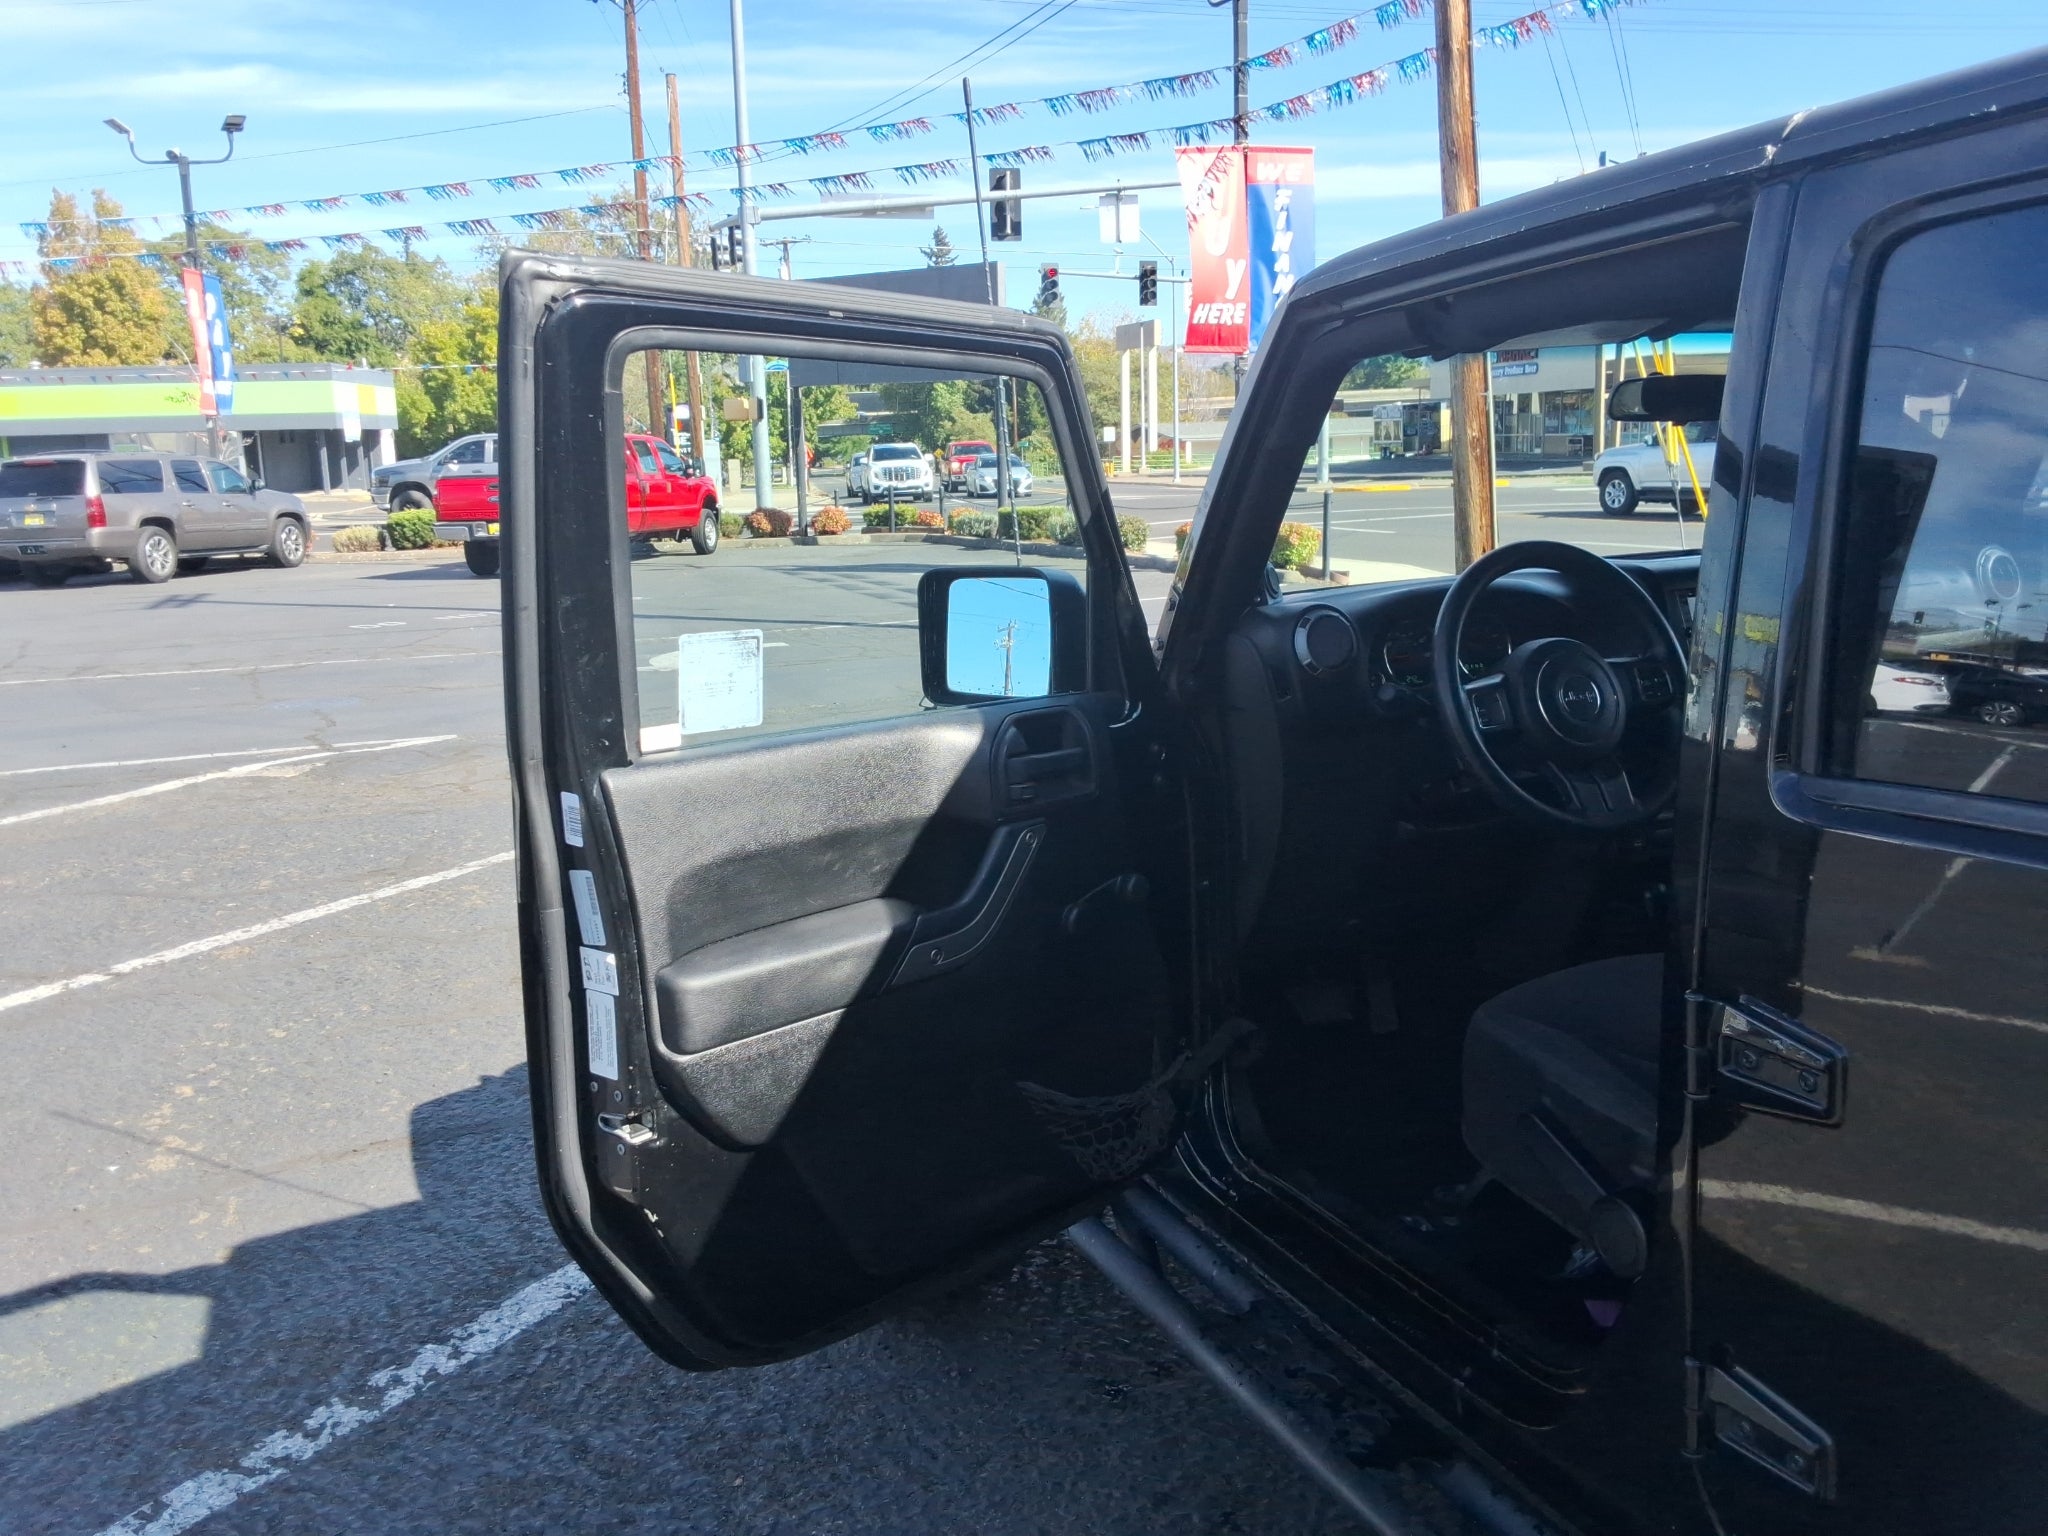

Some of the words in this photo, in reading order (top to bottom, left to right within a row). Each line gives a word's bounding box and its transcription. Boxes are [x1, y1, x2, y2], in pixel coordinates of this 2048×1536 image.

[1256, 162, 1305, 182] WE
[1272, 188, 1295, 309] FINAN
[1192, 302, 1247, 325] HERE
